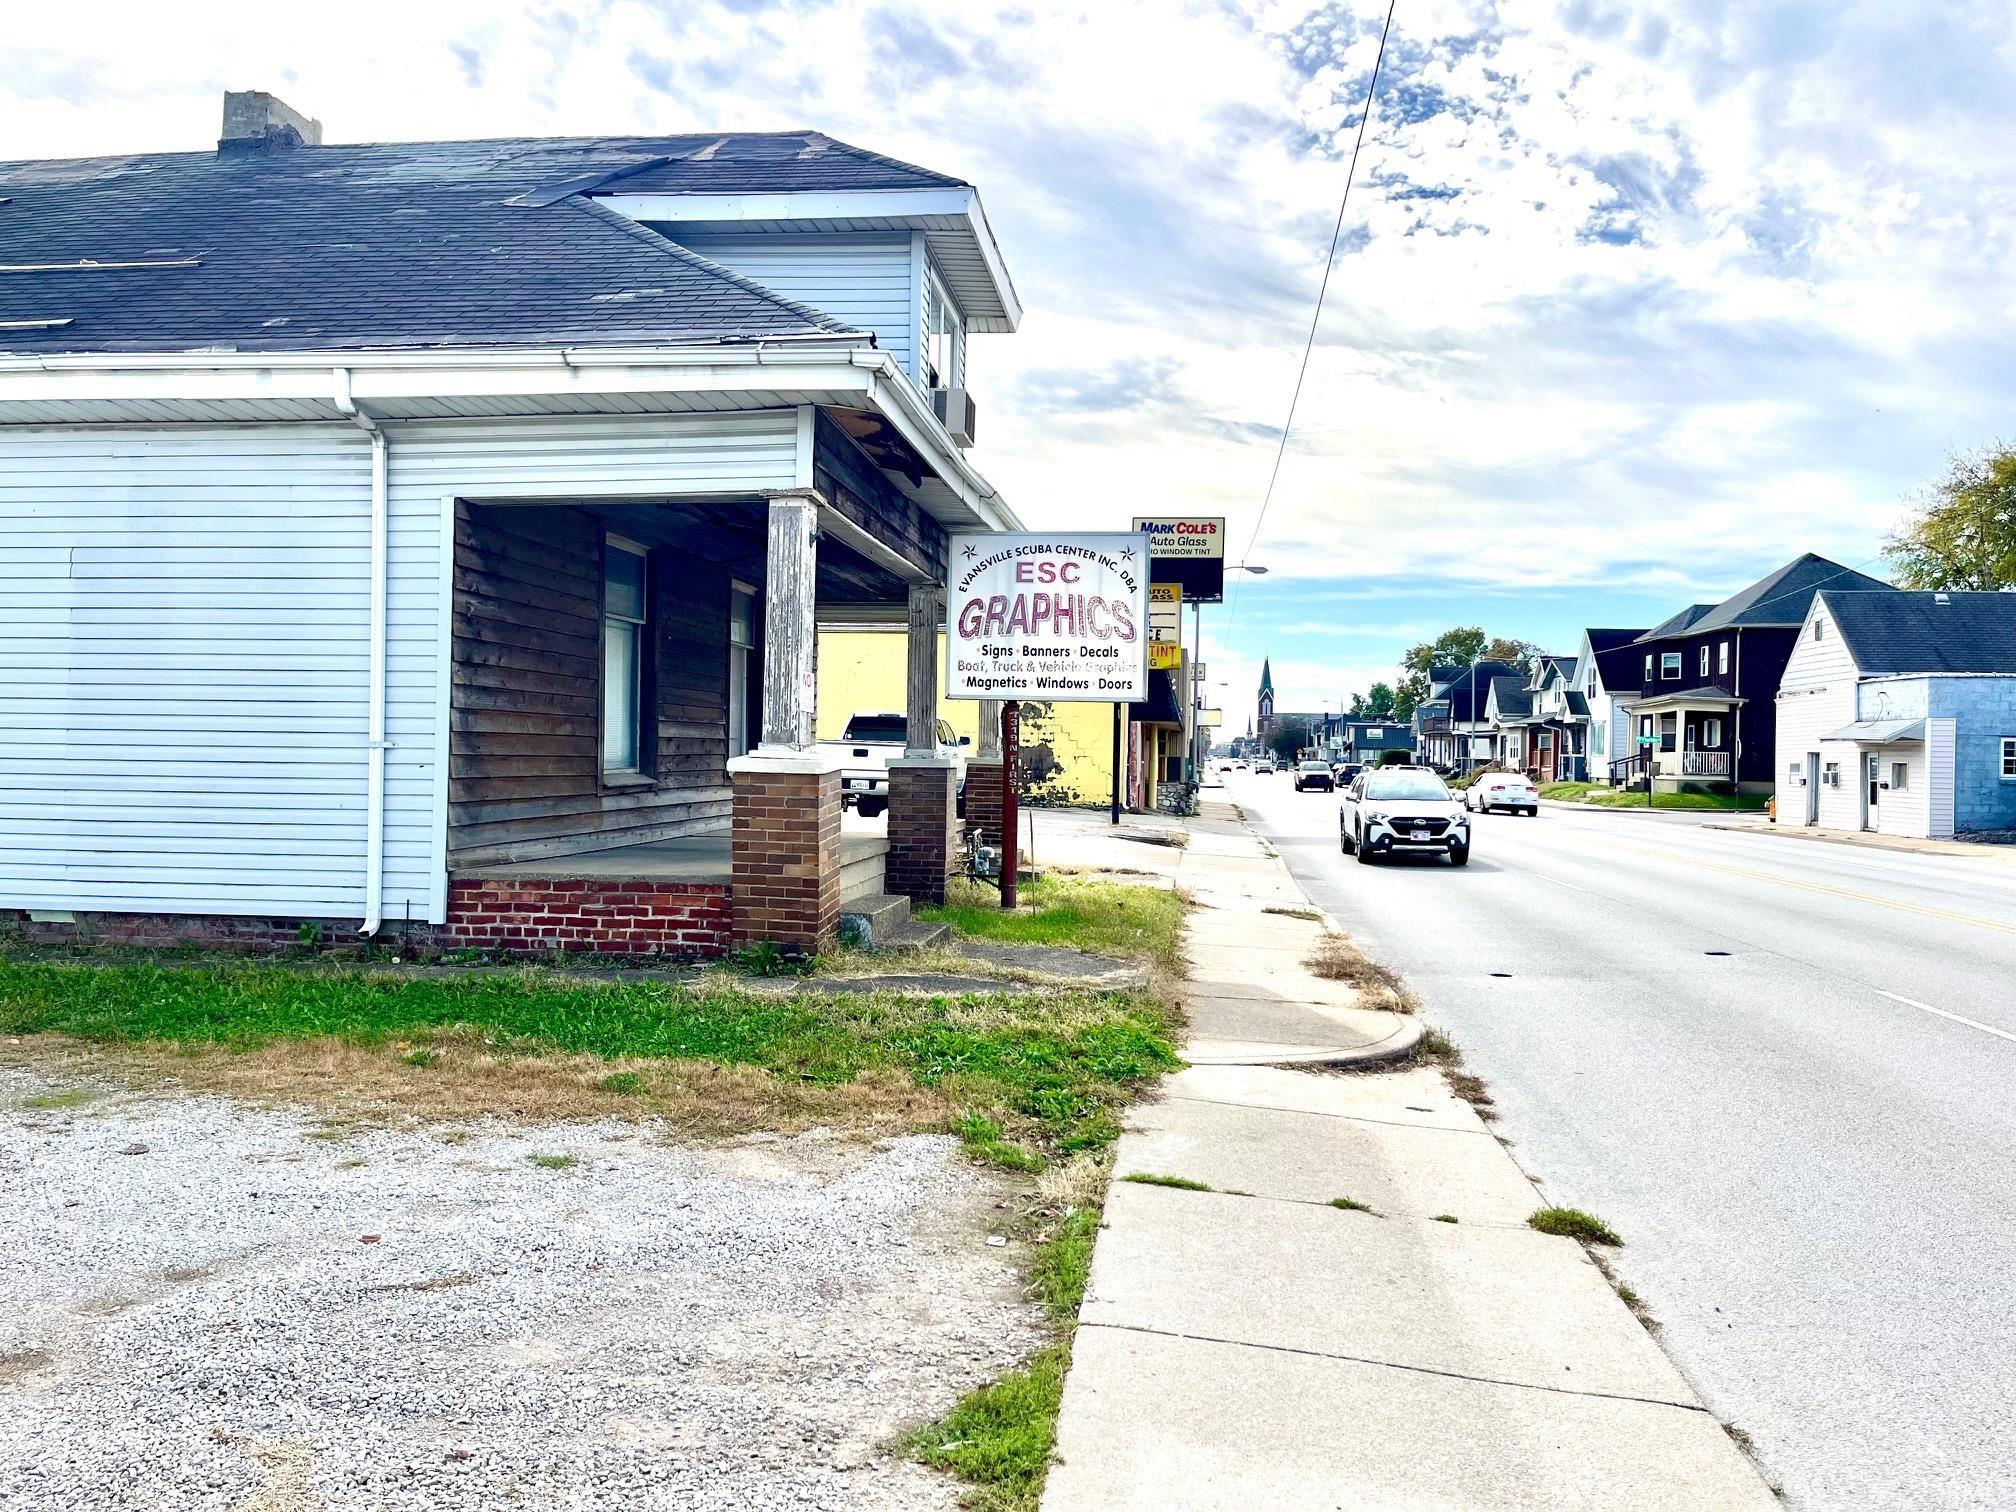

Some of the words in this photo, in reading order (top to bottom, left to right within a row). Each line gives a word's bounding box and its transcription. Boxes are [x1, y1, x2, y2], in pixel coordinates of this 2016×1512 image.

[1141, 522, 1175, 534] MARK
[1176, 522, 1217, 534] COLE'S
[1150, 536, 1175, 546] Auto
[1177, 536, 1207, 546] Glass
[958, 549, 1012, 593] EVANSVILLE
[1015, 544, 1053, 557] SCUBA
[1055, 544, 1096, 561] CENTER
[1098, 554, 1118, 573] INC.
[1120, 570, 1138, 594] DBA
[1015, 561, 1080, 584] ESC
[958, 592, 1137, 642] GRAPHICS
[981, 644, 1013, 659] Signs
[1022, 645, 1071, 657] Banners
[1079, 646, 1119, 658] Decals
[957, 660, 988, 673] Boat,
[992, 660, 1023, 672] Truck
[1026, 661, 1036, 672] &
[1039, 661, 1082, 673] Vehicle
[966, 676, 1027, 691] Magnetics
[1036, 677, 1089, 689] Windows
[1098, 678, 1133, 690] Doors
[1009, 754, 1018, 794] FIRST
